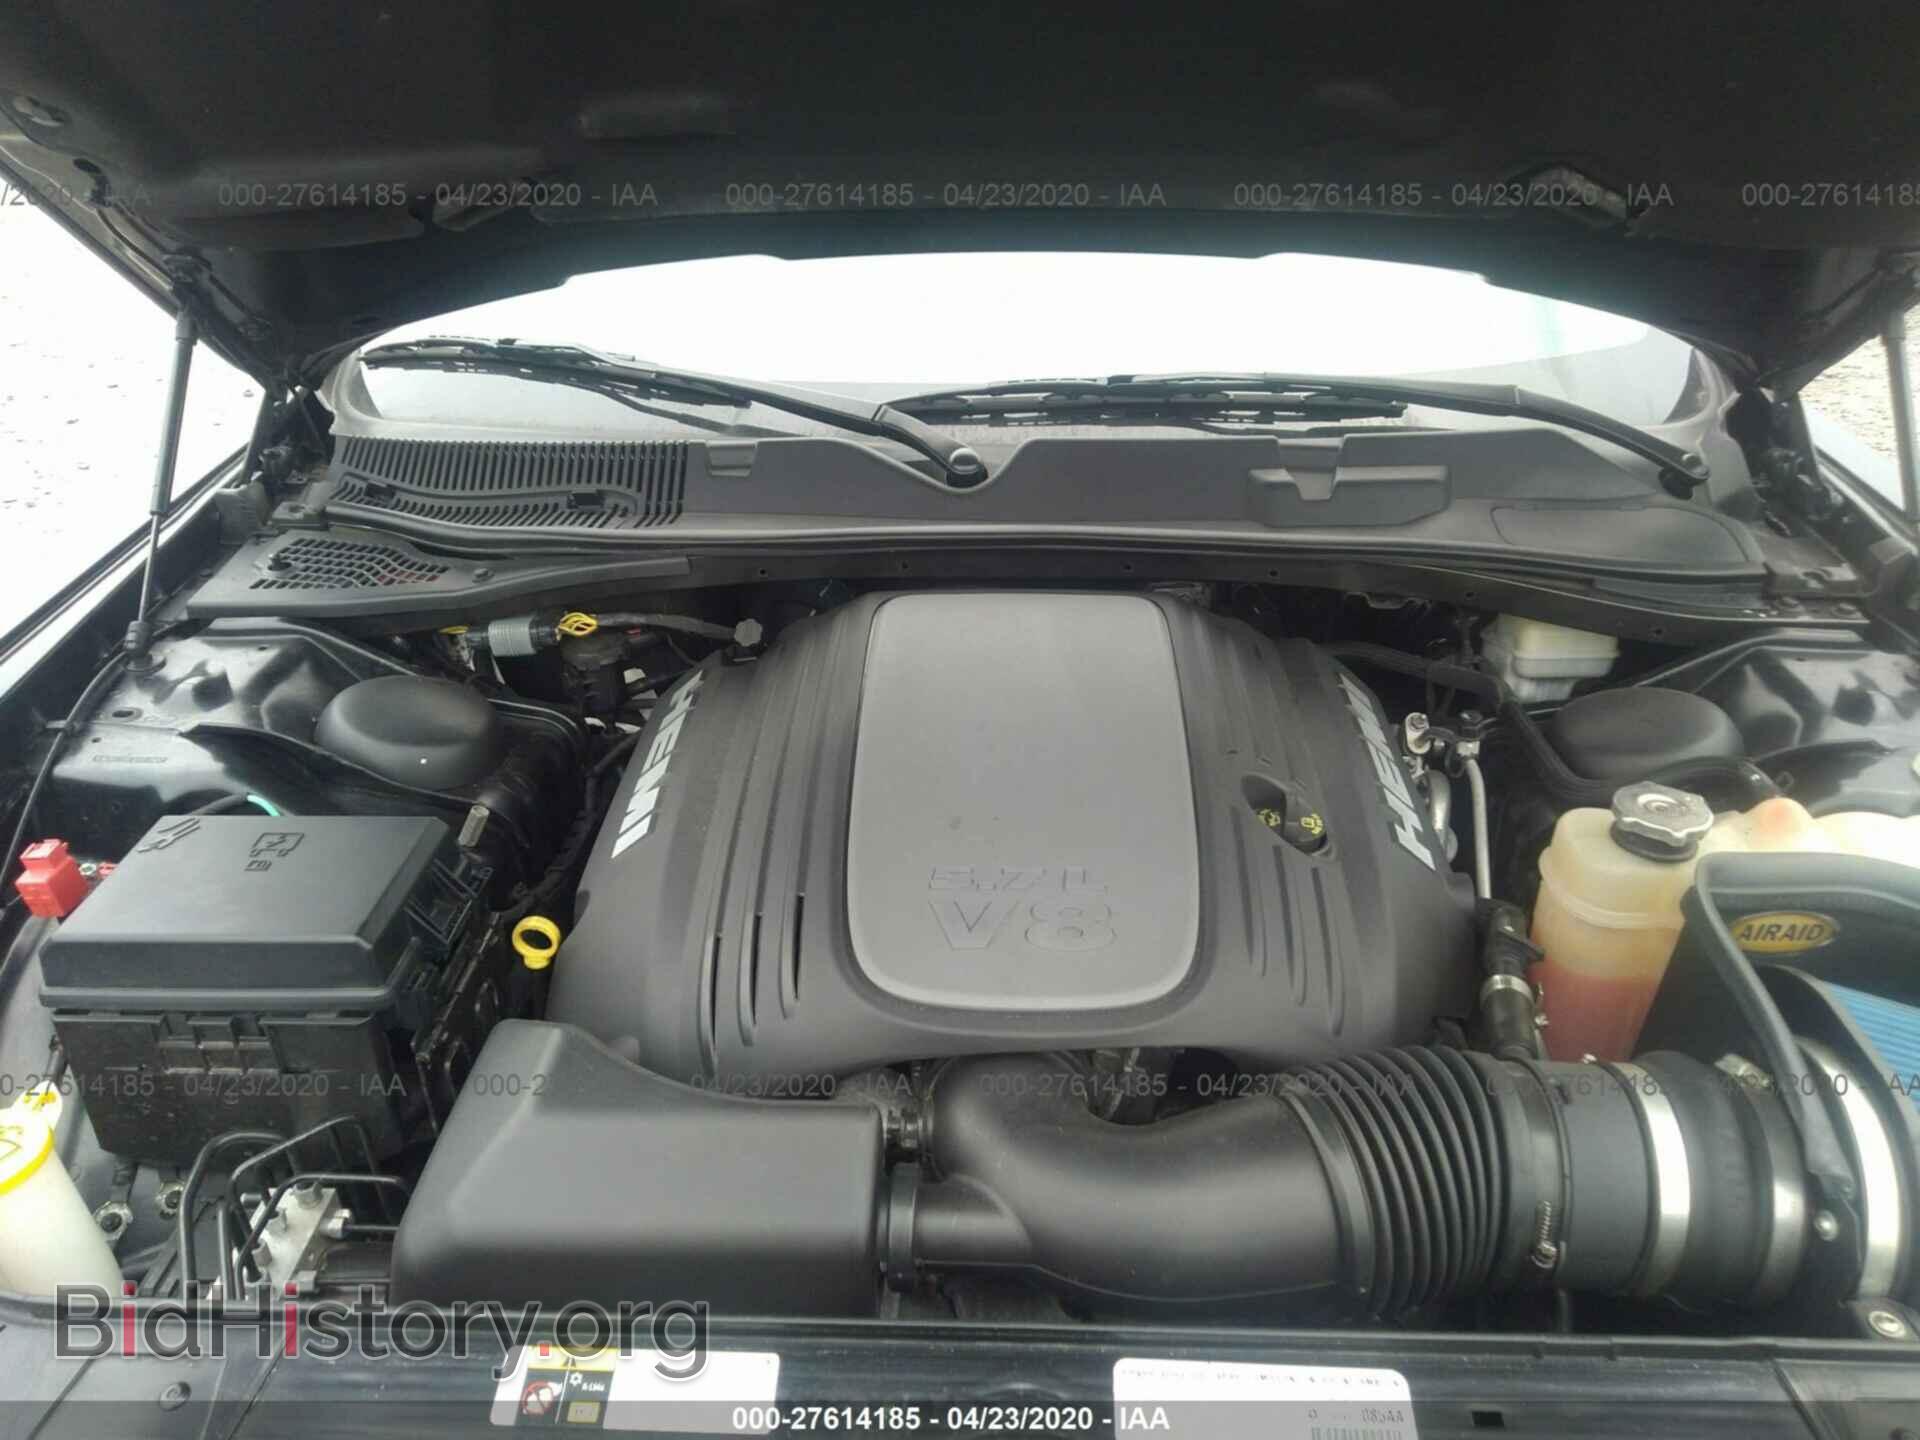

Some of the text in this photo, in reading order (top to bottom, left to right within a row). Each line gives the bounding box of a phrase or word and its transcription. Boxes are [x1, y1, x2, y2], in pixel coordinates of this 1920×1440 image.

[611, 670, 703, 859] HEMI
[1339, 673, 1437, 871] HEMI
[928, 897, 1119, 953] V8
[1737, 922, 1825, 943] AIRAID
